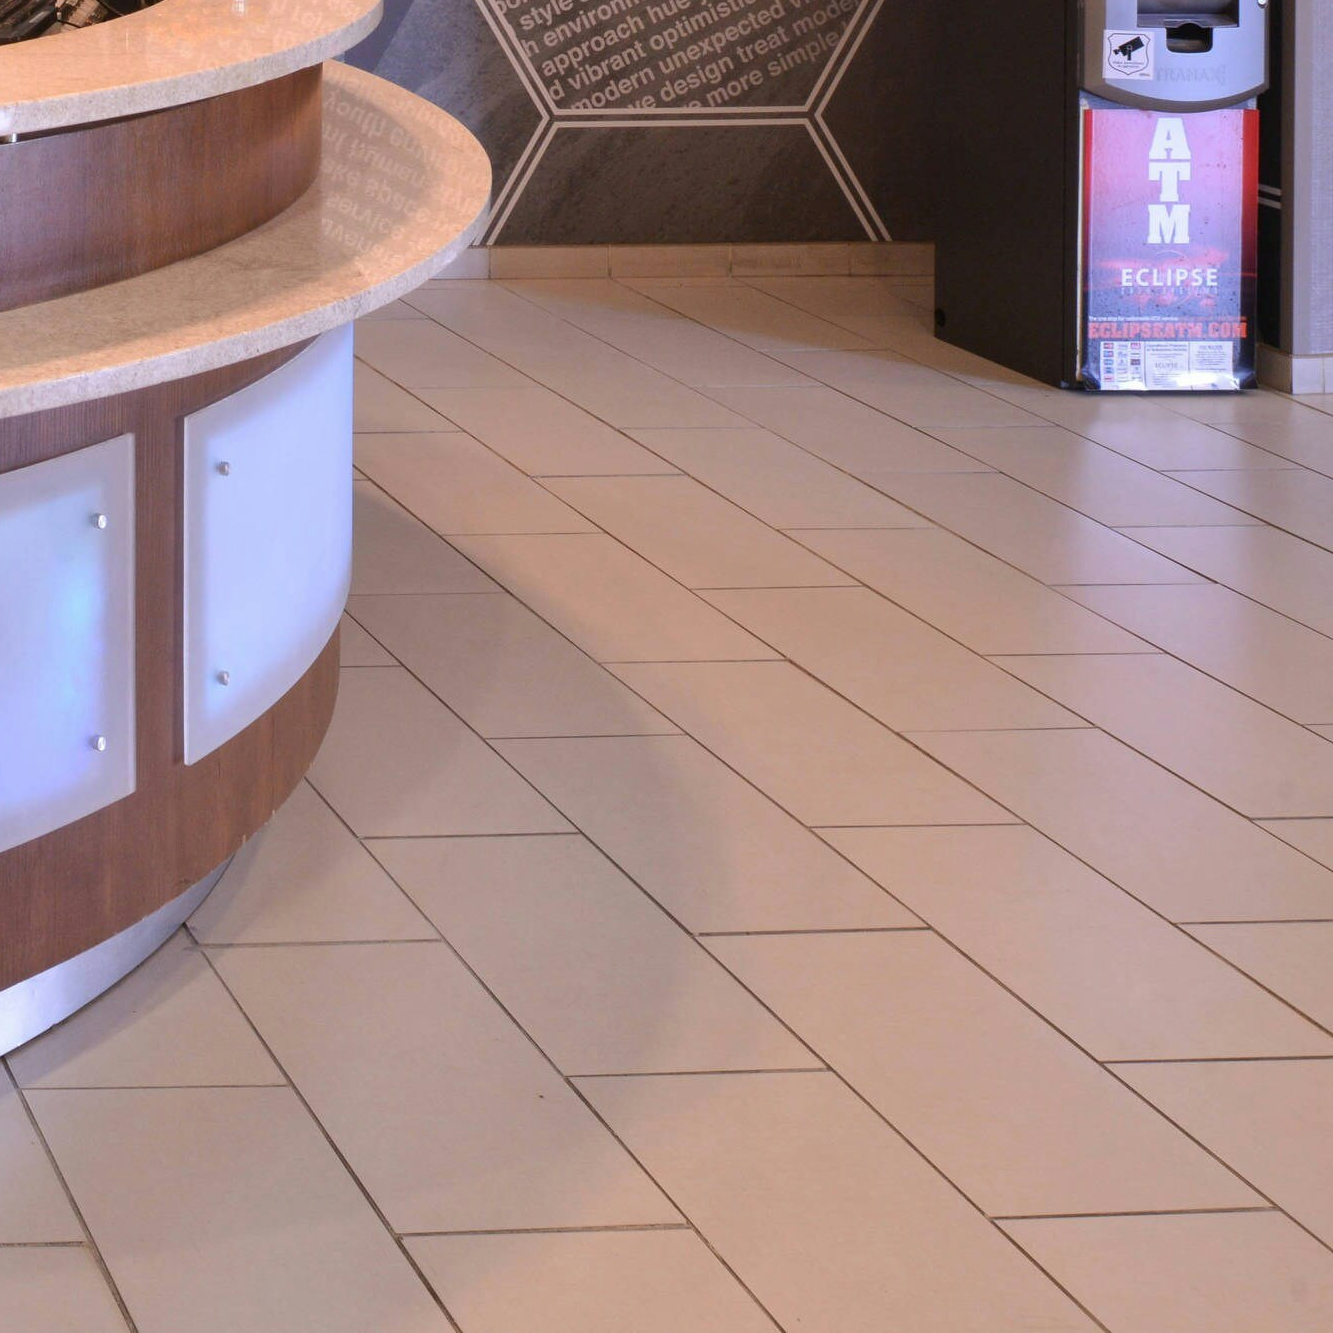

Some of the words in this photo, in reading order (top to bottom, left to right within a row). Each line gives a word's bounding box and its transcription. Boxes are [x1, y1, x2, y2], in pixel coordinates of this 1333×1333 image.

[569, 39, 645, 90] vibrant
[658, 56, 733, 101] design
[735, 25, 788, 63] treat
[1120, 268, 1219, 287] ECLIPSE
